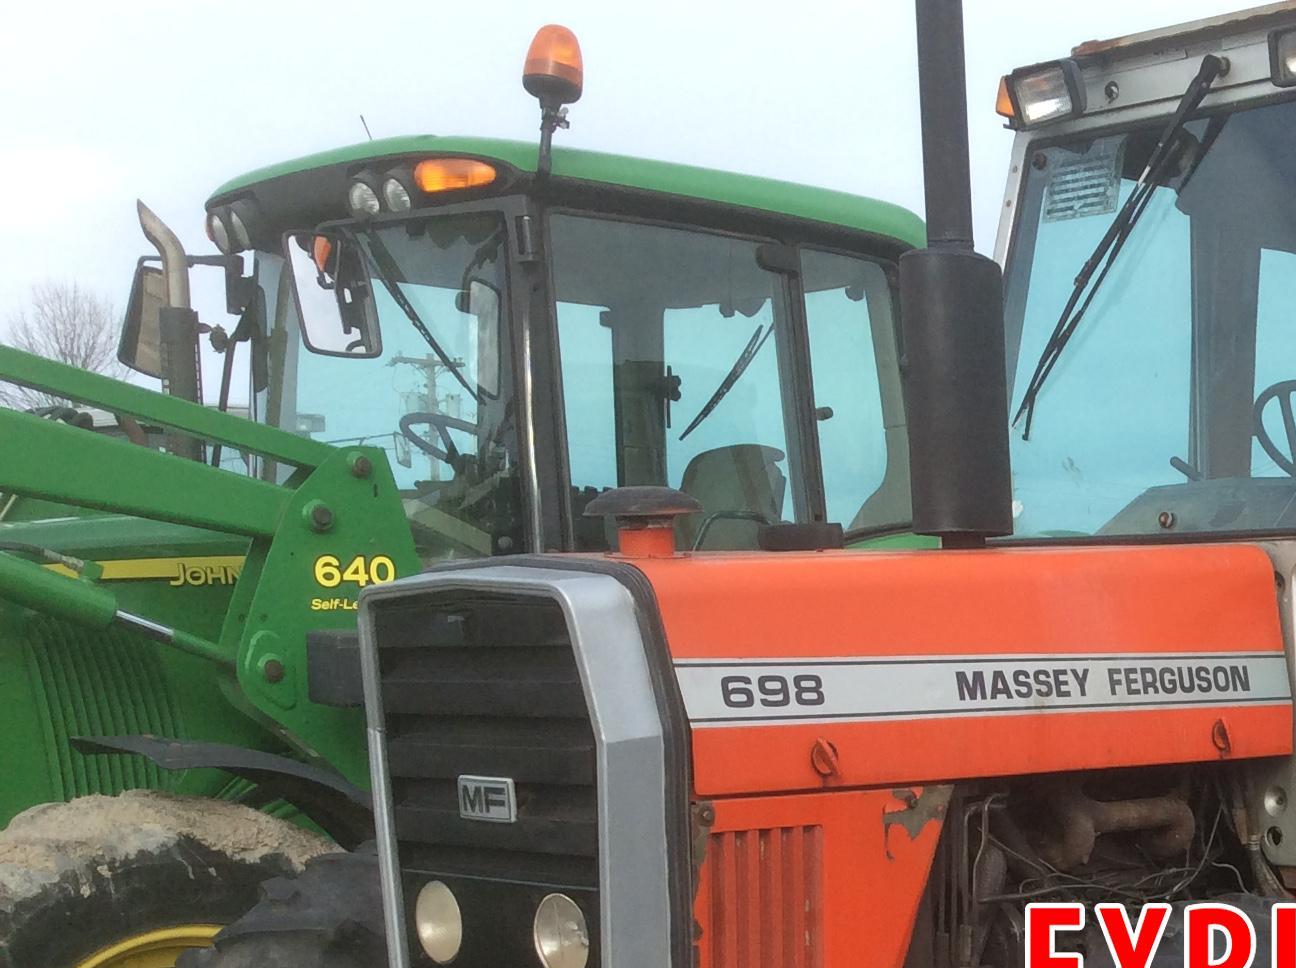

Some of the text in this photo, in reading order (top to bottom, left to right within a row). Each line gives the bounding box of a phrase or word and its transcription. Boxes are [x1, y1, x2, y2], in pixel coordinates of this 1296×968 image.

[170, 563, 243, 586] JOHN
[314, 555, 396, 586] 640
[721, 674, 825, 708] 698
[955, 665, 1250, 701] MASSEY FERGUSON
[462, 784, 506, 813] MF
